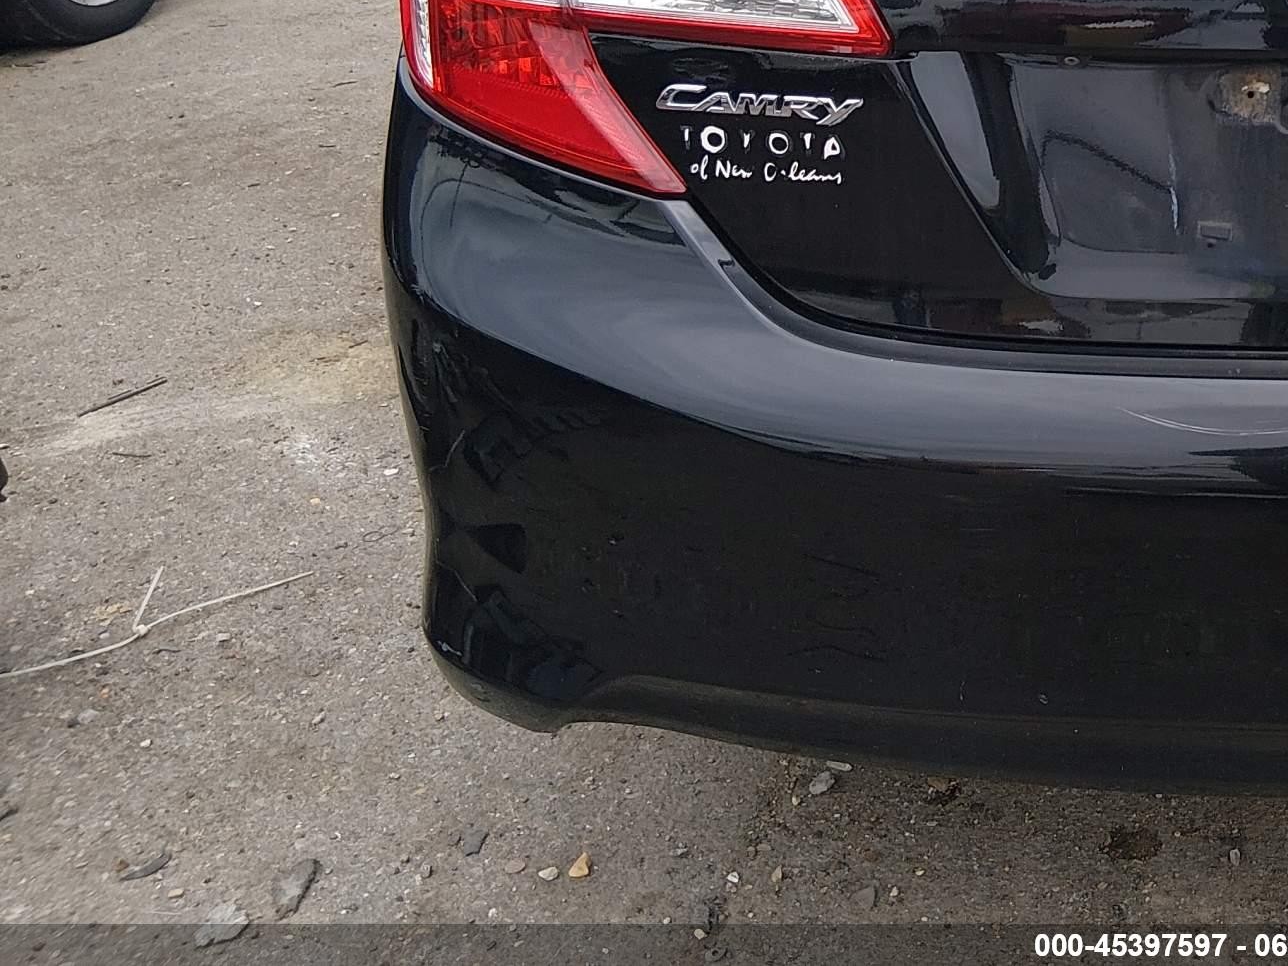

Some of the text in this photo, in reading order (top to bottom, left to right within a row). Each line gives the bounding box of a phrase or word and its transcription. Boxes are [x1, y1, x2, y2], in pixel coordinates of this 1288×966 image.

[656, 83, 864, 126] CAMRY
[681, 125, 844, 160] TOYOTA
[690, 154, 708, 180] of
[715, 159, 753, 179] New
